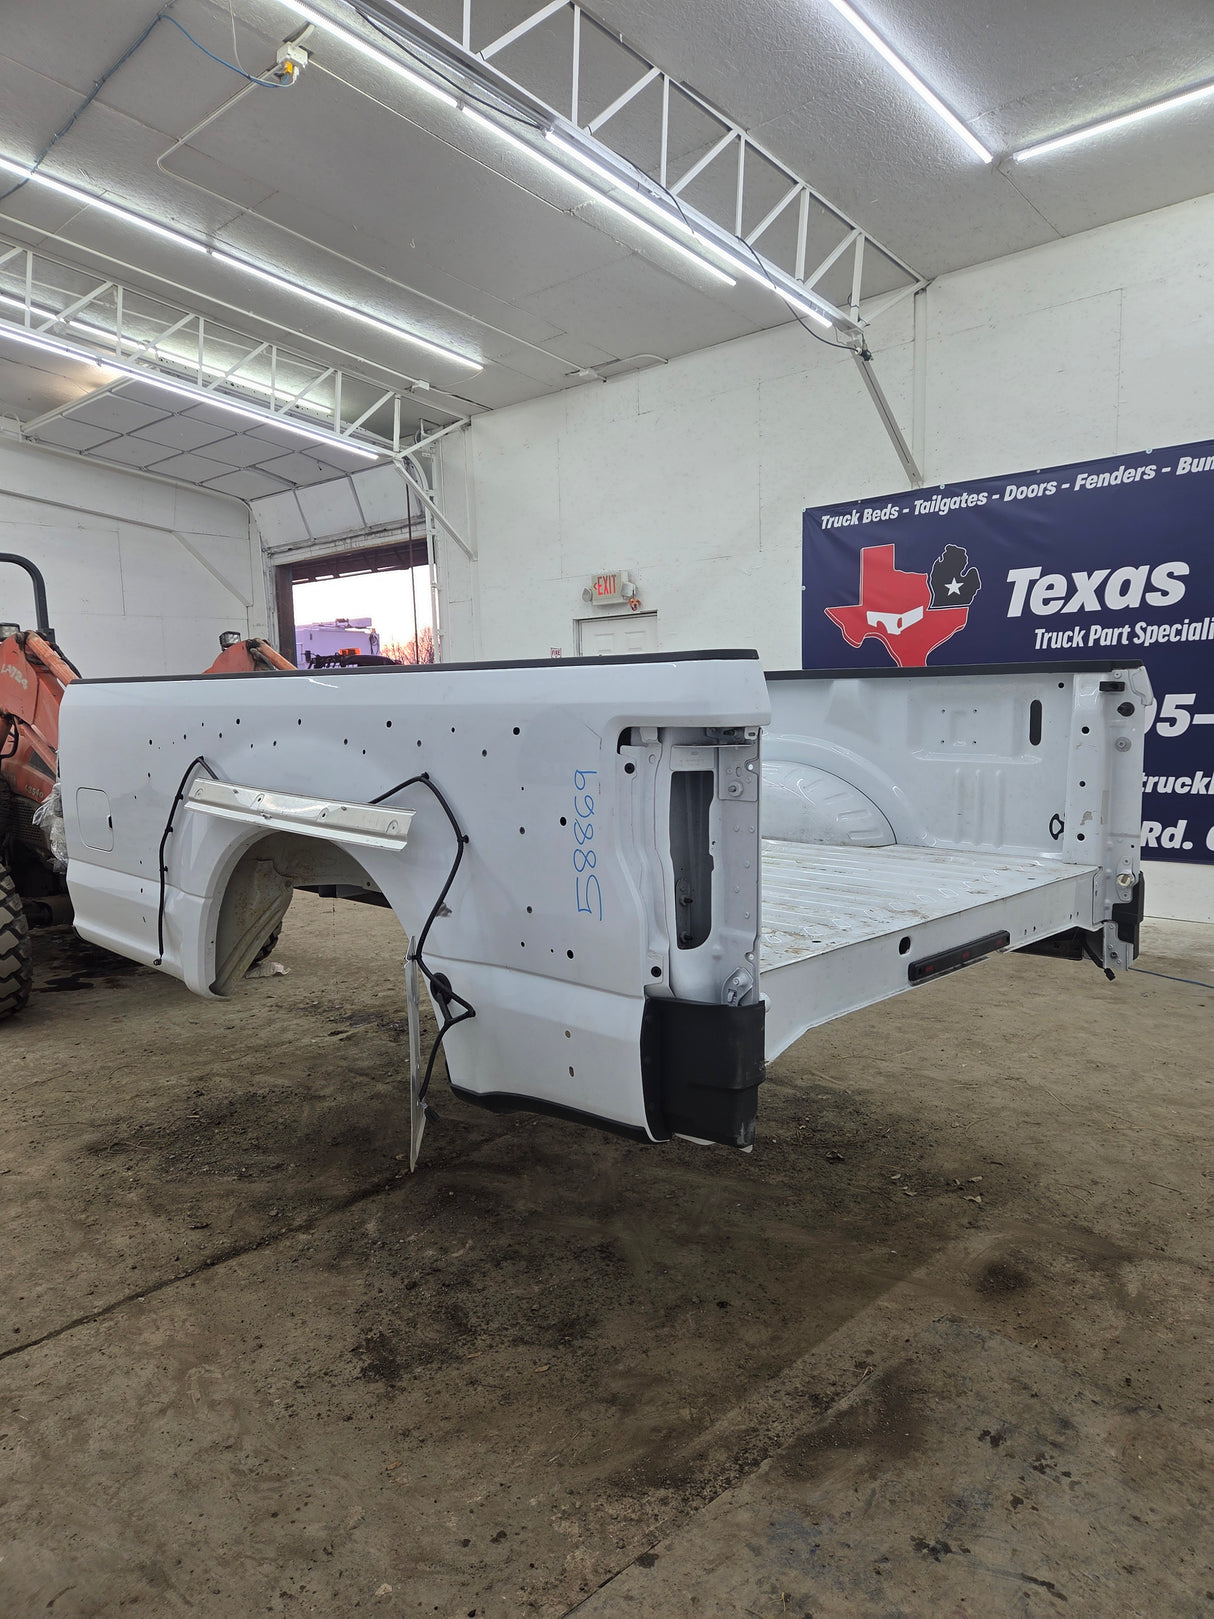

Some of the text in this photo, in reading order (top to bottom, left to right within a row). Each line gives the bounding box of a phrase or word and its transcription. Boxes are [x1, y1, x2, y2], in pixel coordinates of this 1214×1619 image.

[821, 511, 859, 529] Truck
[862, 504, 899, 522] Beds
[914, 492, 988, 515] Tailgates
[1003, 481, 1058, 502] Doors
[1074, 465, 1157, 491] Fenders
[597, 574, 616, 595] EXIT
[1006, 561, 1190, 618] Texas
[1034, 626, 1086, 650] Truck
[1088, 624, 1131, 647] Part
[573, 769, 602, 921] 58869
[1140, 819, 1193, 850] Rd.
